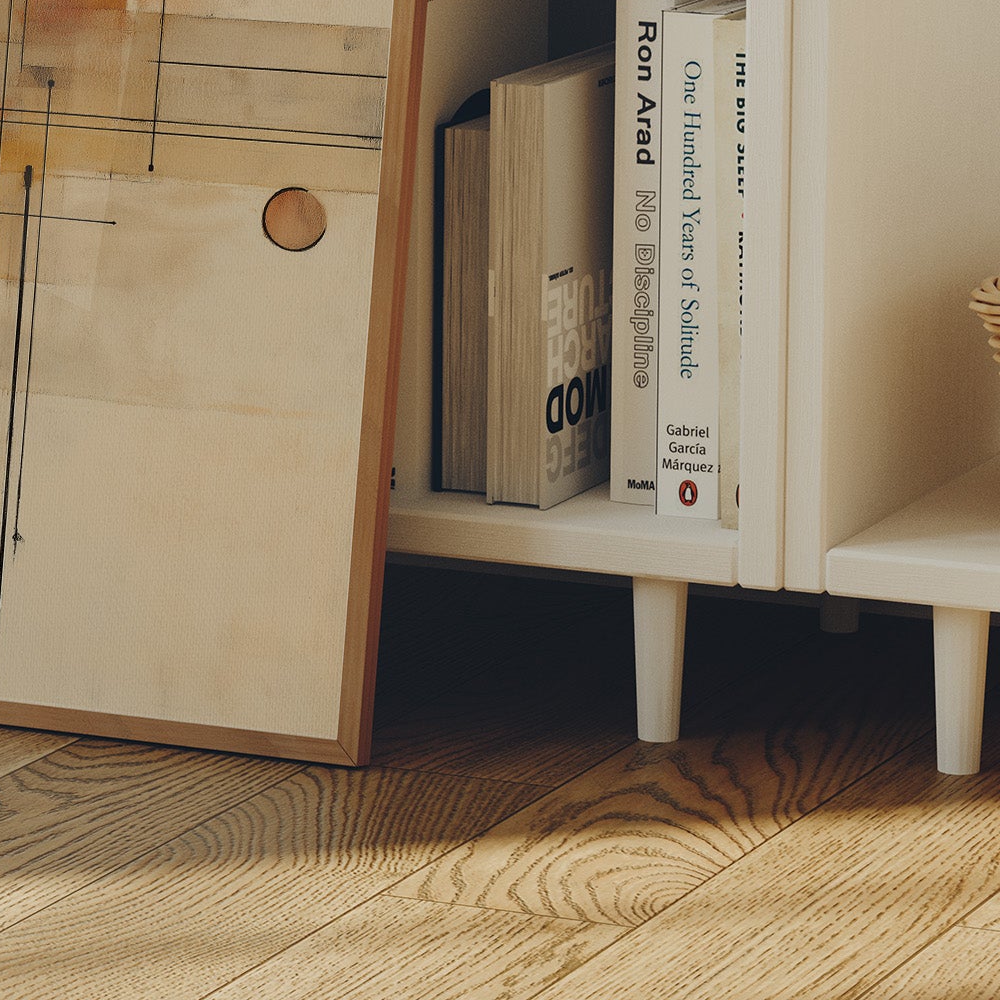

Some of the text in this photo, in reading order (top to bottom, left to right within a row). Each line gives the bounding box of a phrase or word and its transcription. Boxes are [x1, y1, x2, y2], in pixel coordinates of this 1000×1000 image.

[630, 20, 657, 388] Ron Arad No Discipline
[680, 60, 702, 379] One Hundred Years of Solitude
[546, 364, 607, 434] MOD
[666, 424, 709, 438] Gabriel
[668, 441, 706, 456] García
[662, 458, 714, 474] Márquez
[627, 479, 655, 491] MoMA
